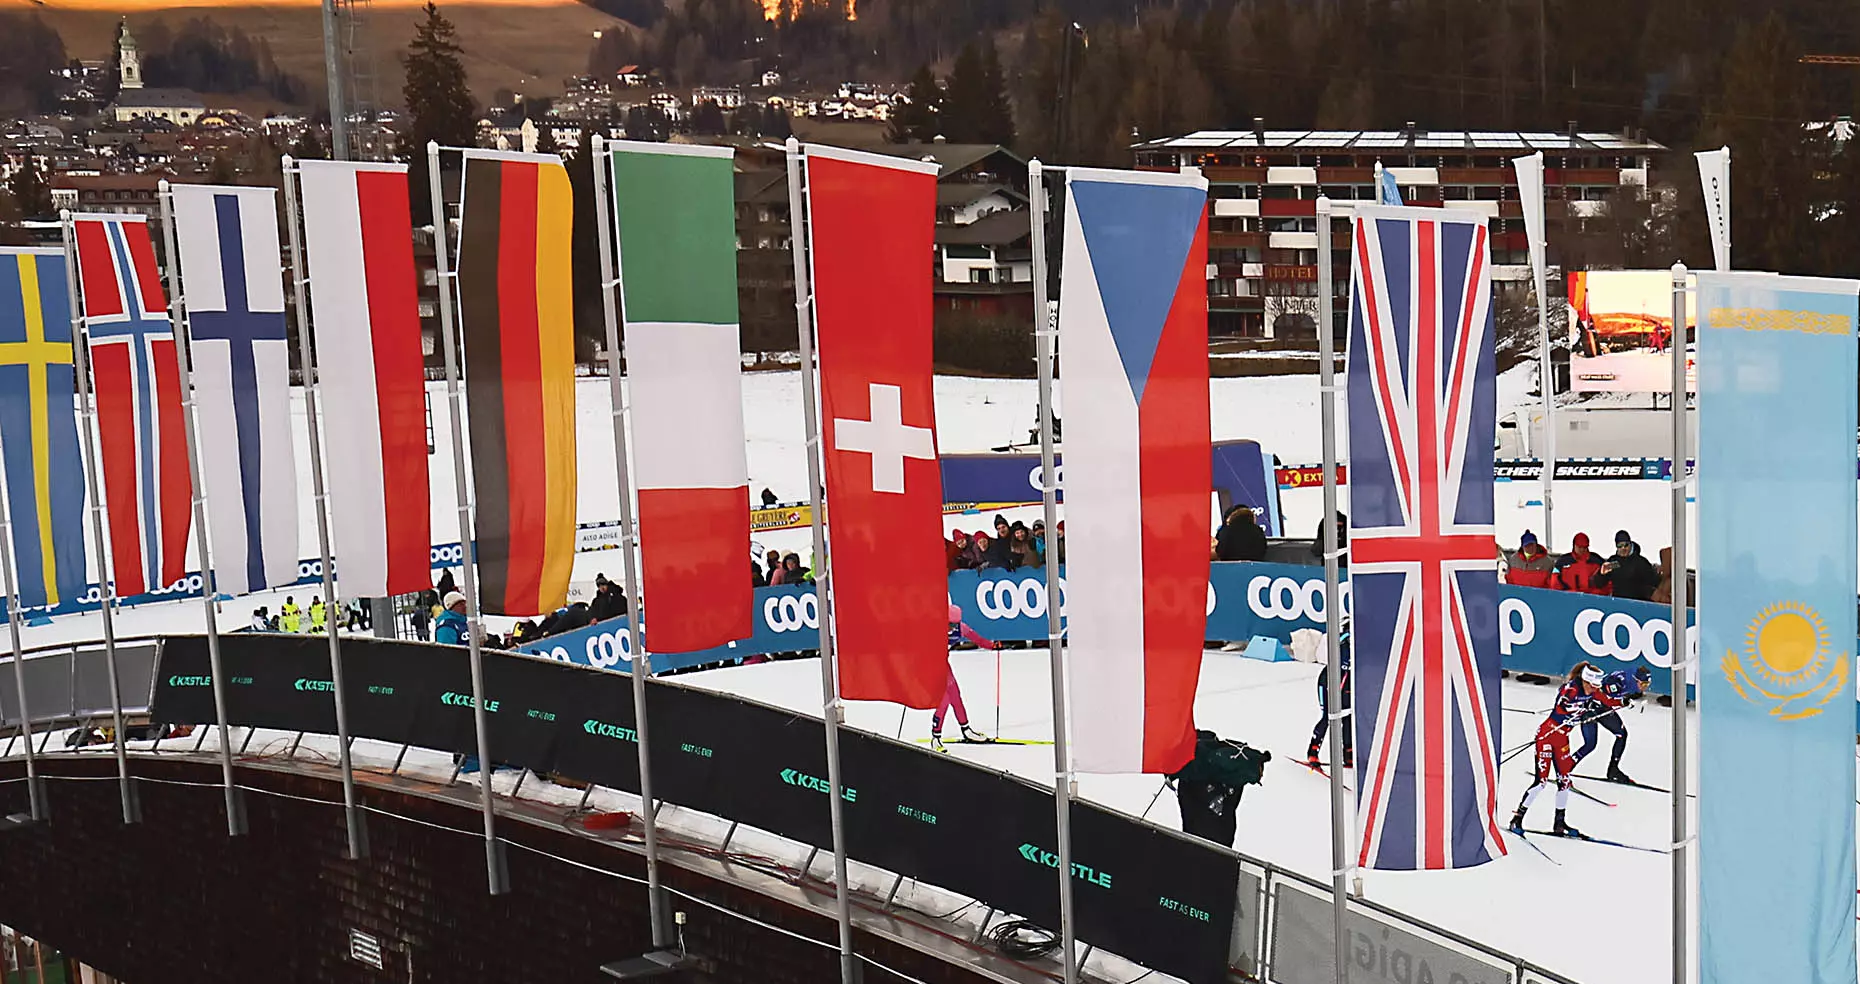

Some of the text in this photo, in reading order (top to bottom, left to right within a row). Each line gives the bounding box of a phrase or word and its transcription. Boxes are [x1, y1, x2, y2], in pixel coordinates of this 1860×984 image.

[1556, 466, 1642, 476] SKECHERS
[764, 592, 819, 634] coo
[1573, 608, 1697, 670] coo
[897, 804, 912, 816] FAST
[922, 811, 936, 825] EVER
[1159, 896, 1210, 923] FAST AS EVER
